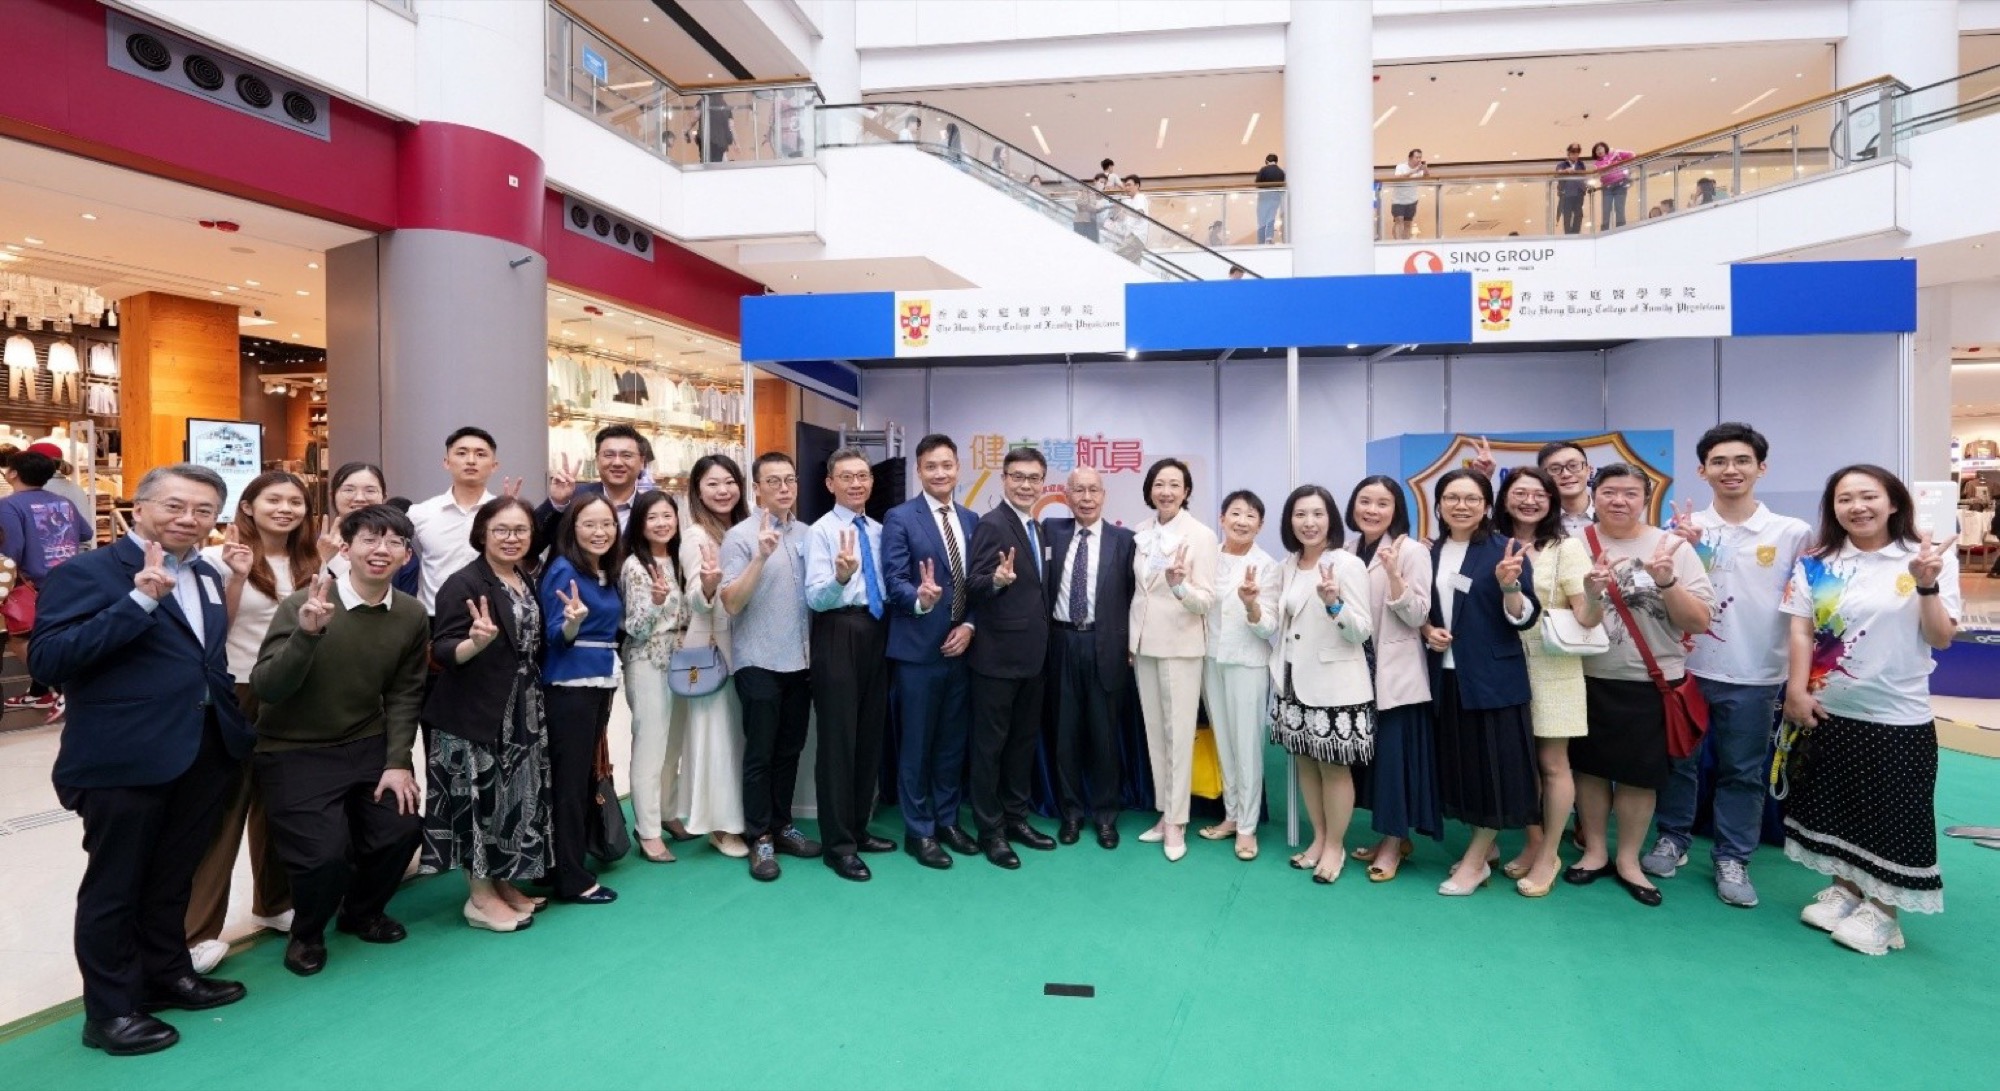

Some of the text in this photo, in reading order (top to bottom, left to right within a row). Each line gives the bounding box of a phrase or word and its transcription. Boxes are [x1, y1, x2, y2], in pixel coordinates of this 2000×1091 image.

[1450, 249, 1554, 264] SINO GROUP
[1519, 302, 1726, 317] The Hong Kong College of Family Physicians
[936, 324, 952, 334] The
[954, 323, 977, 334] Hong
[978, 323, 1001, 334] Kong
[1002, 322, 1032, 333] College
[1033, 321, 1042, 330] of
[1044, 321, 1073, 331] Family
